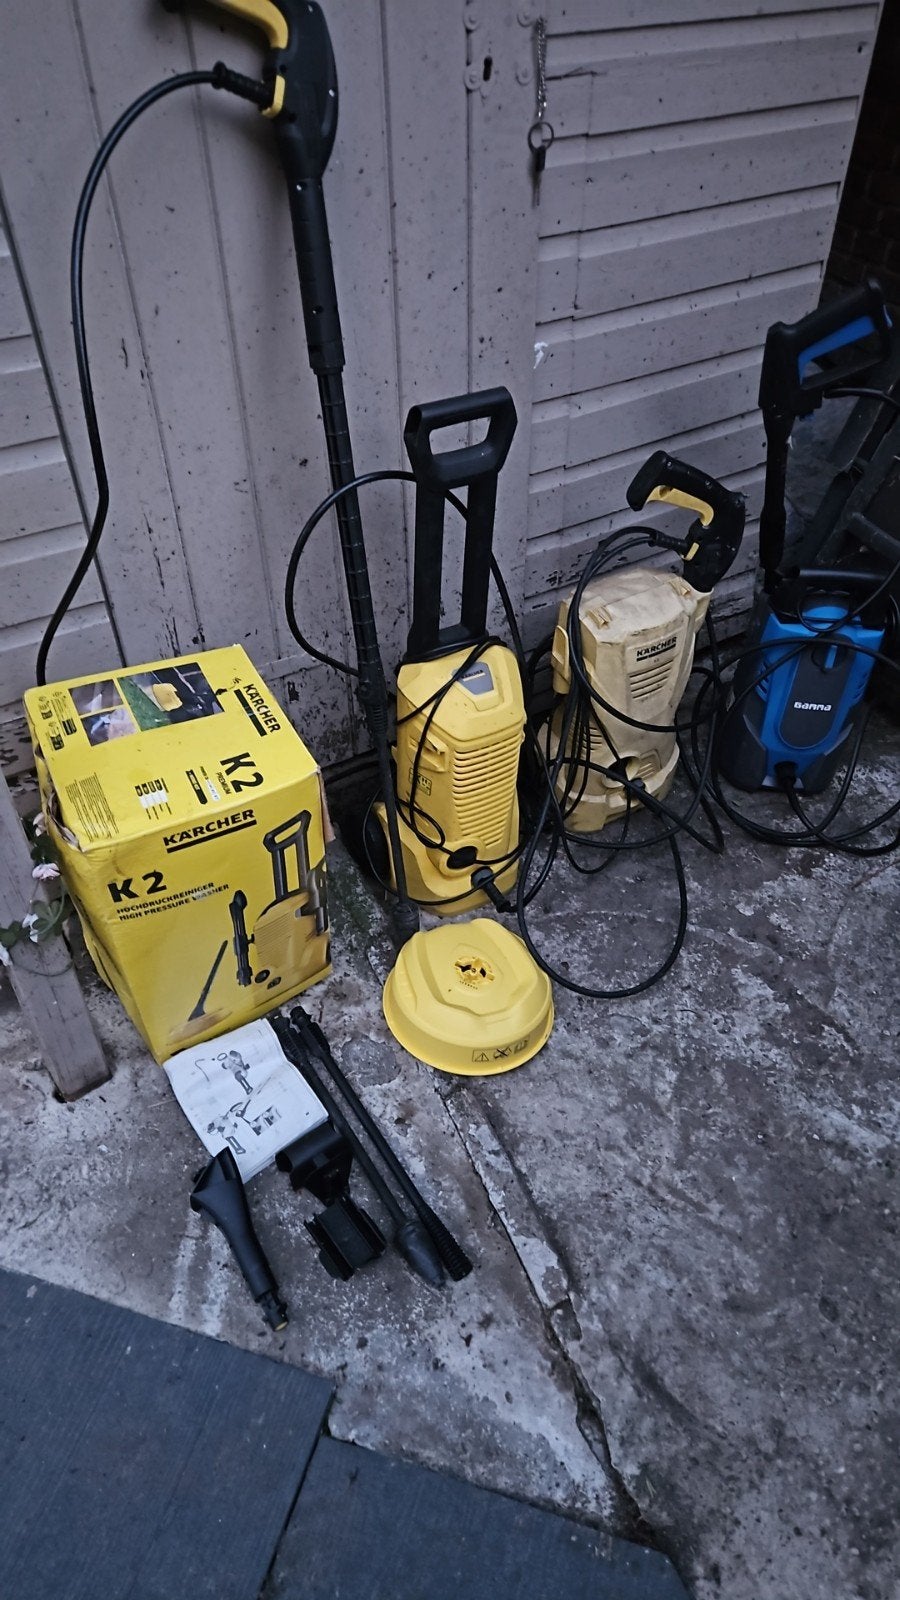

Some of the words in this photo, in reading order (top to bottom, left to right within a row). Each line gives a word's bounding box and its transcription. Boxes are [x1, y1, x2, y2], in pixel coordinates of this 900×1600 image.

[243, 683, 281, 733] KÄRCHER
[162, 809, 255, 846] KÄRCHER
[116, 882, 215, 914] HOCHDRUCKREINIGER
[119, 908, 142, 921] HIGH
[144, 898, 191, 916] PRESSURE
